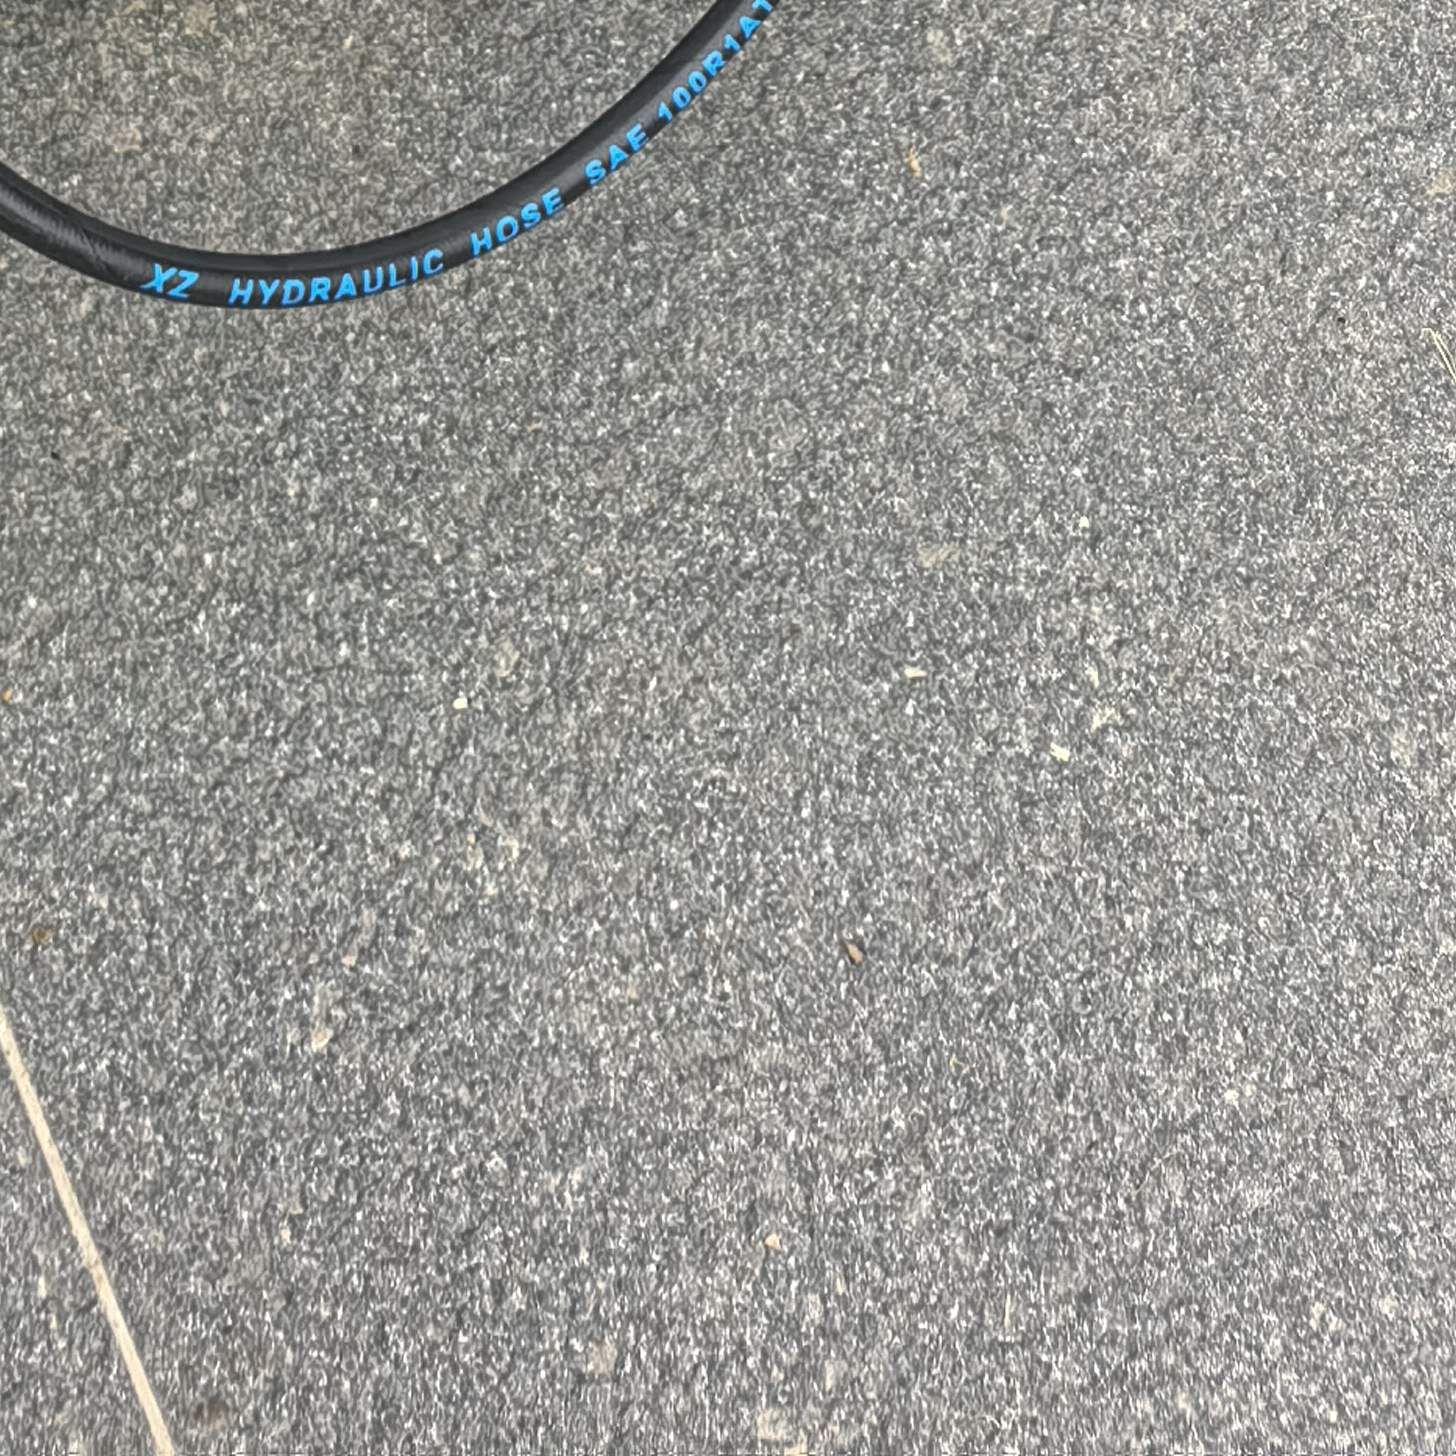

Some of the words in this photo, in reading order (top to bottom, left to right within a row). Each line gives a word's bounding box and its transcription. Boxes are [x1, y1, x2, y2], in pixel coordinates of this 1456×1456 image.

[140, 263, 200, 301] XZ
[228, 249, 444, 307] HYDRAULIC
[470, 188, 564, 258] HOSE
[584, 123, 647, 187] SAE
